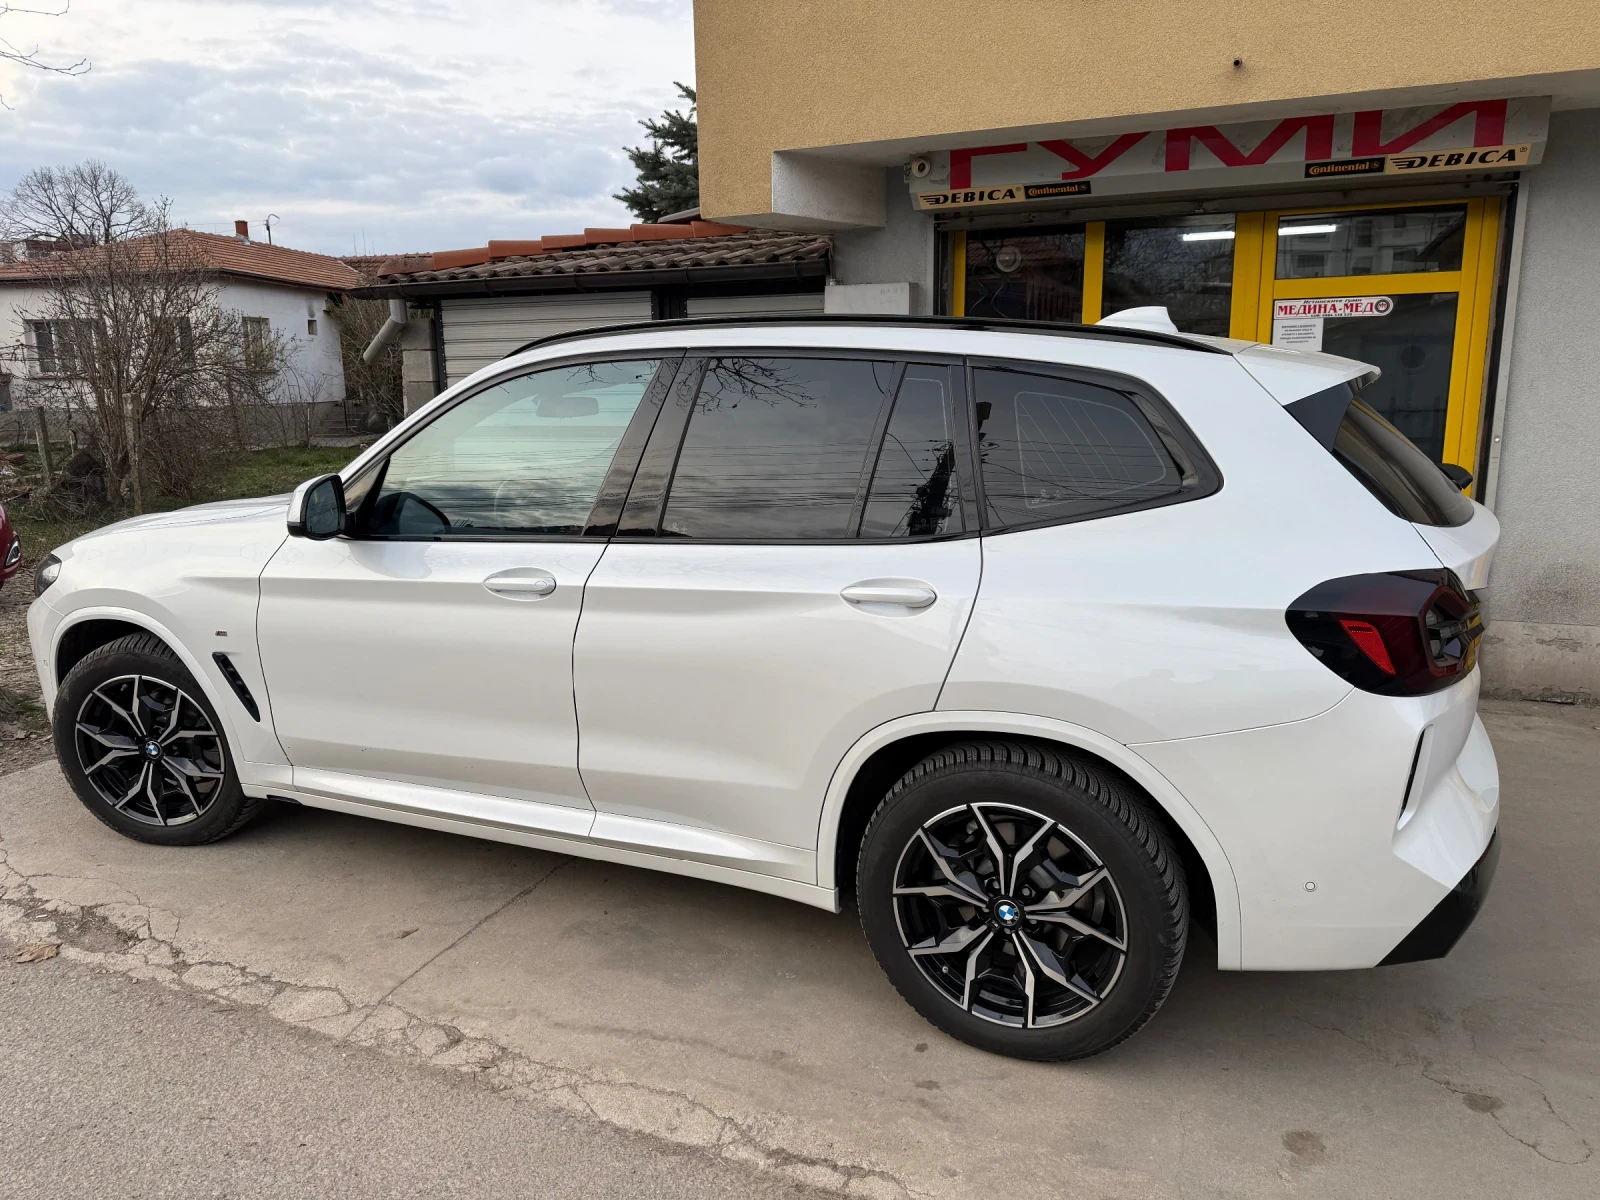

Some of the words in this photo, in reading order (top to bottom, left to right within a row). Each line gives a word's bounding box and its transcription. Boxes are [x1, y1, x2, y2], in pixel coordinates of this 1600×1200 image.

[949, 99, 1508, 190] ГУМИ
[1308, 161, 1370, 176] Continental
[1028, 184, 1079, 197] Continental
[1277, 302, 1375, 317] МЕДИНА-МЕД
